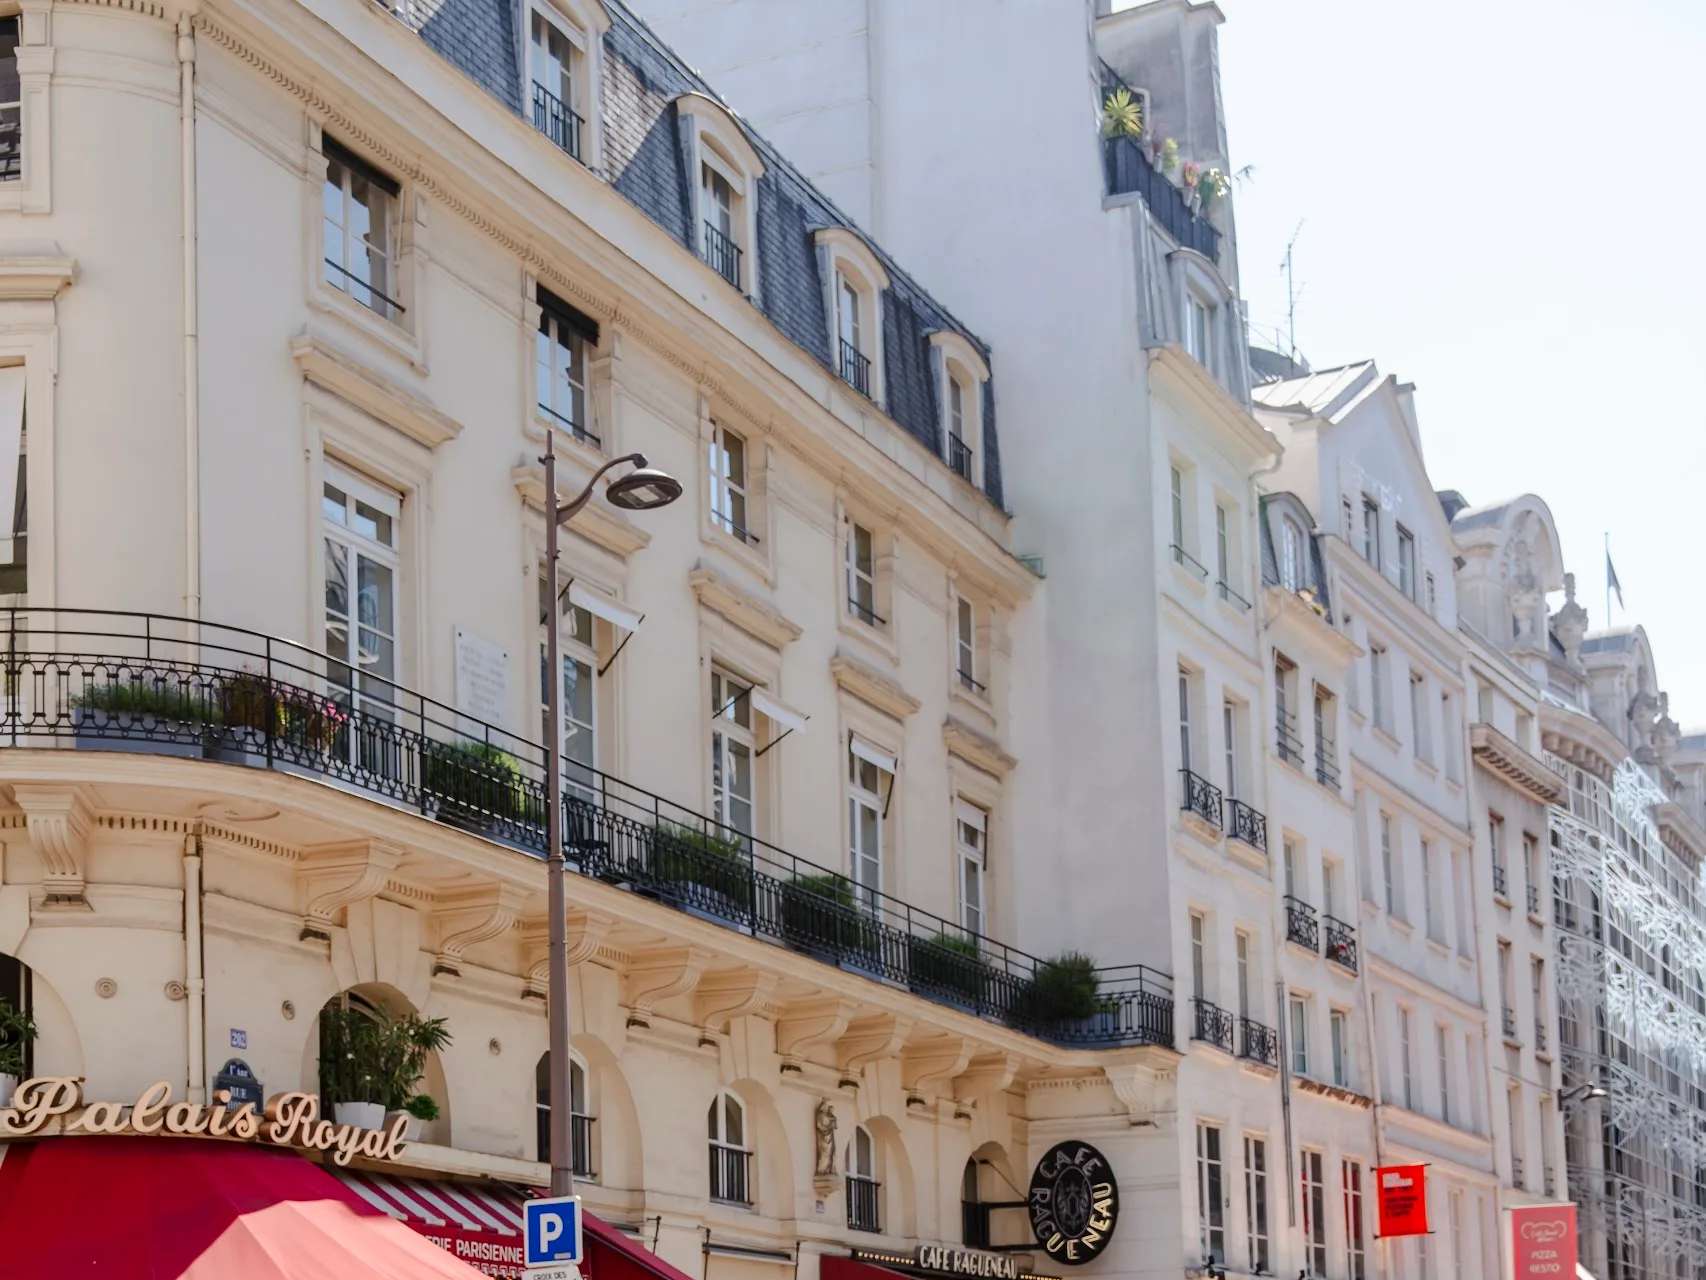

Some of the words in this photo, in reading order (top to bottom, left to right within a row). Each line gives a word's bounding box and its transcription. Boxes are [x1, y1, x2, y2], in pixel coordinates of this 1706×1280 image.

[230, 1086, 247, 1099] RUE
[2, 1076, 257, 1139] Palais
[267, 1091, 411, 1166] Royal
[1040, 1147, 1103, 1179] CAFE
[539, 1212, 564, 1253] P
[1031, 1182, 1112, 1260] RAGUENEAU
[456, 1239, 524, 1265] PARISIENNE
[919, 1246, 950, 1271] CAFE
[953, 1251, 1018, 1280] RAGUENEAU
[1531, 1249, 1558, 1260] PIZZA
[554, 1271, 567, 1279] DES
[1529, 1263, 1561, 1273] RESTO
